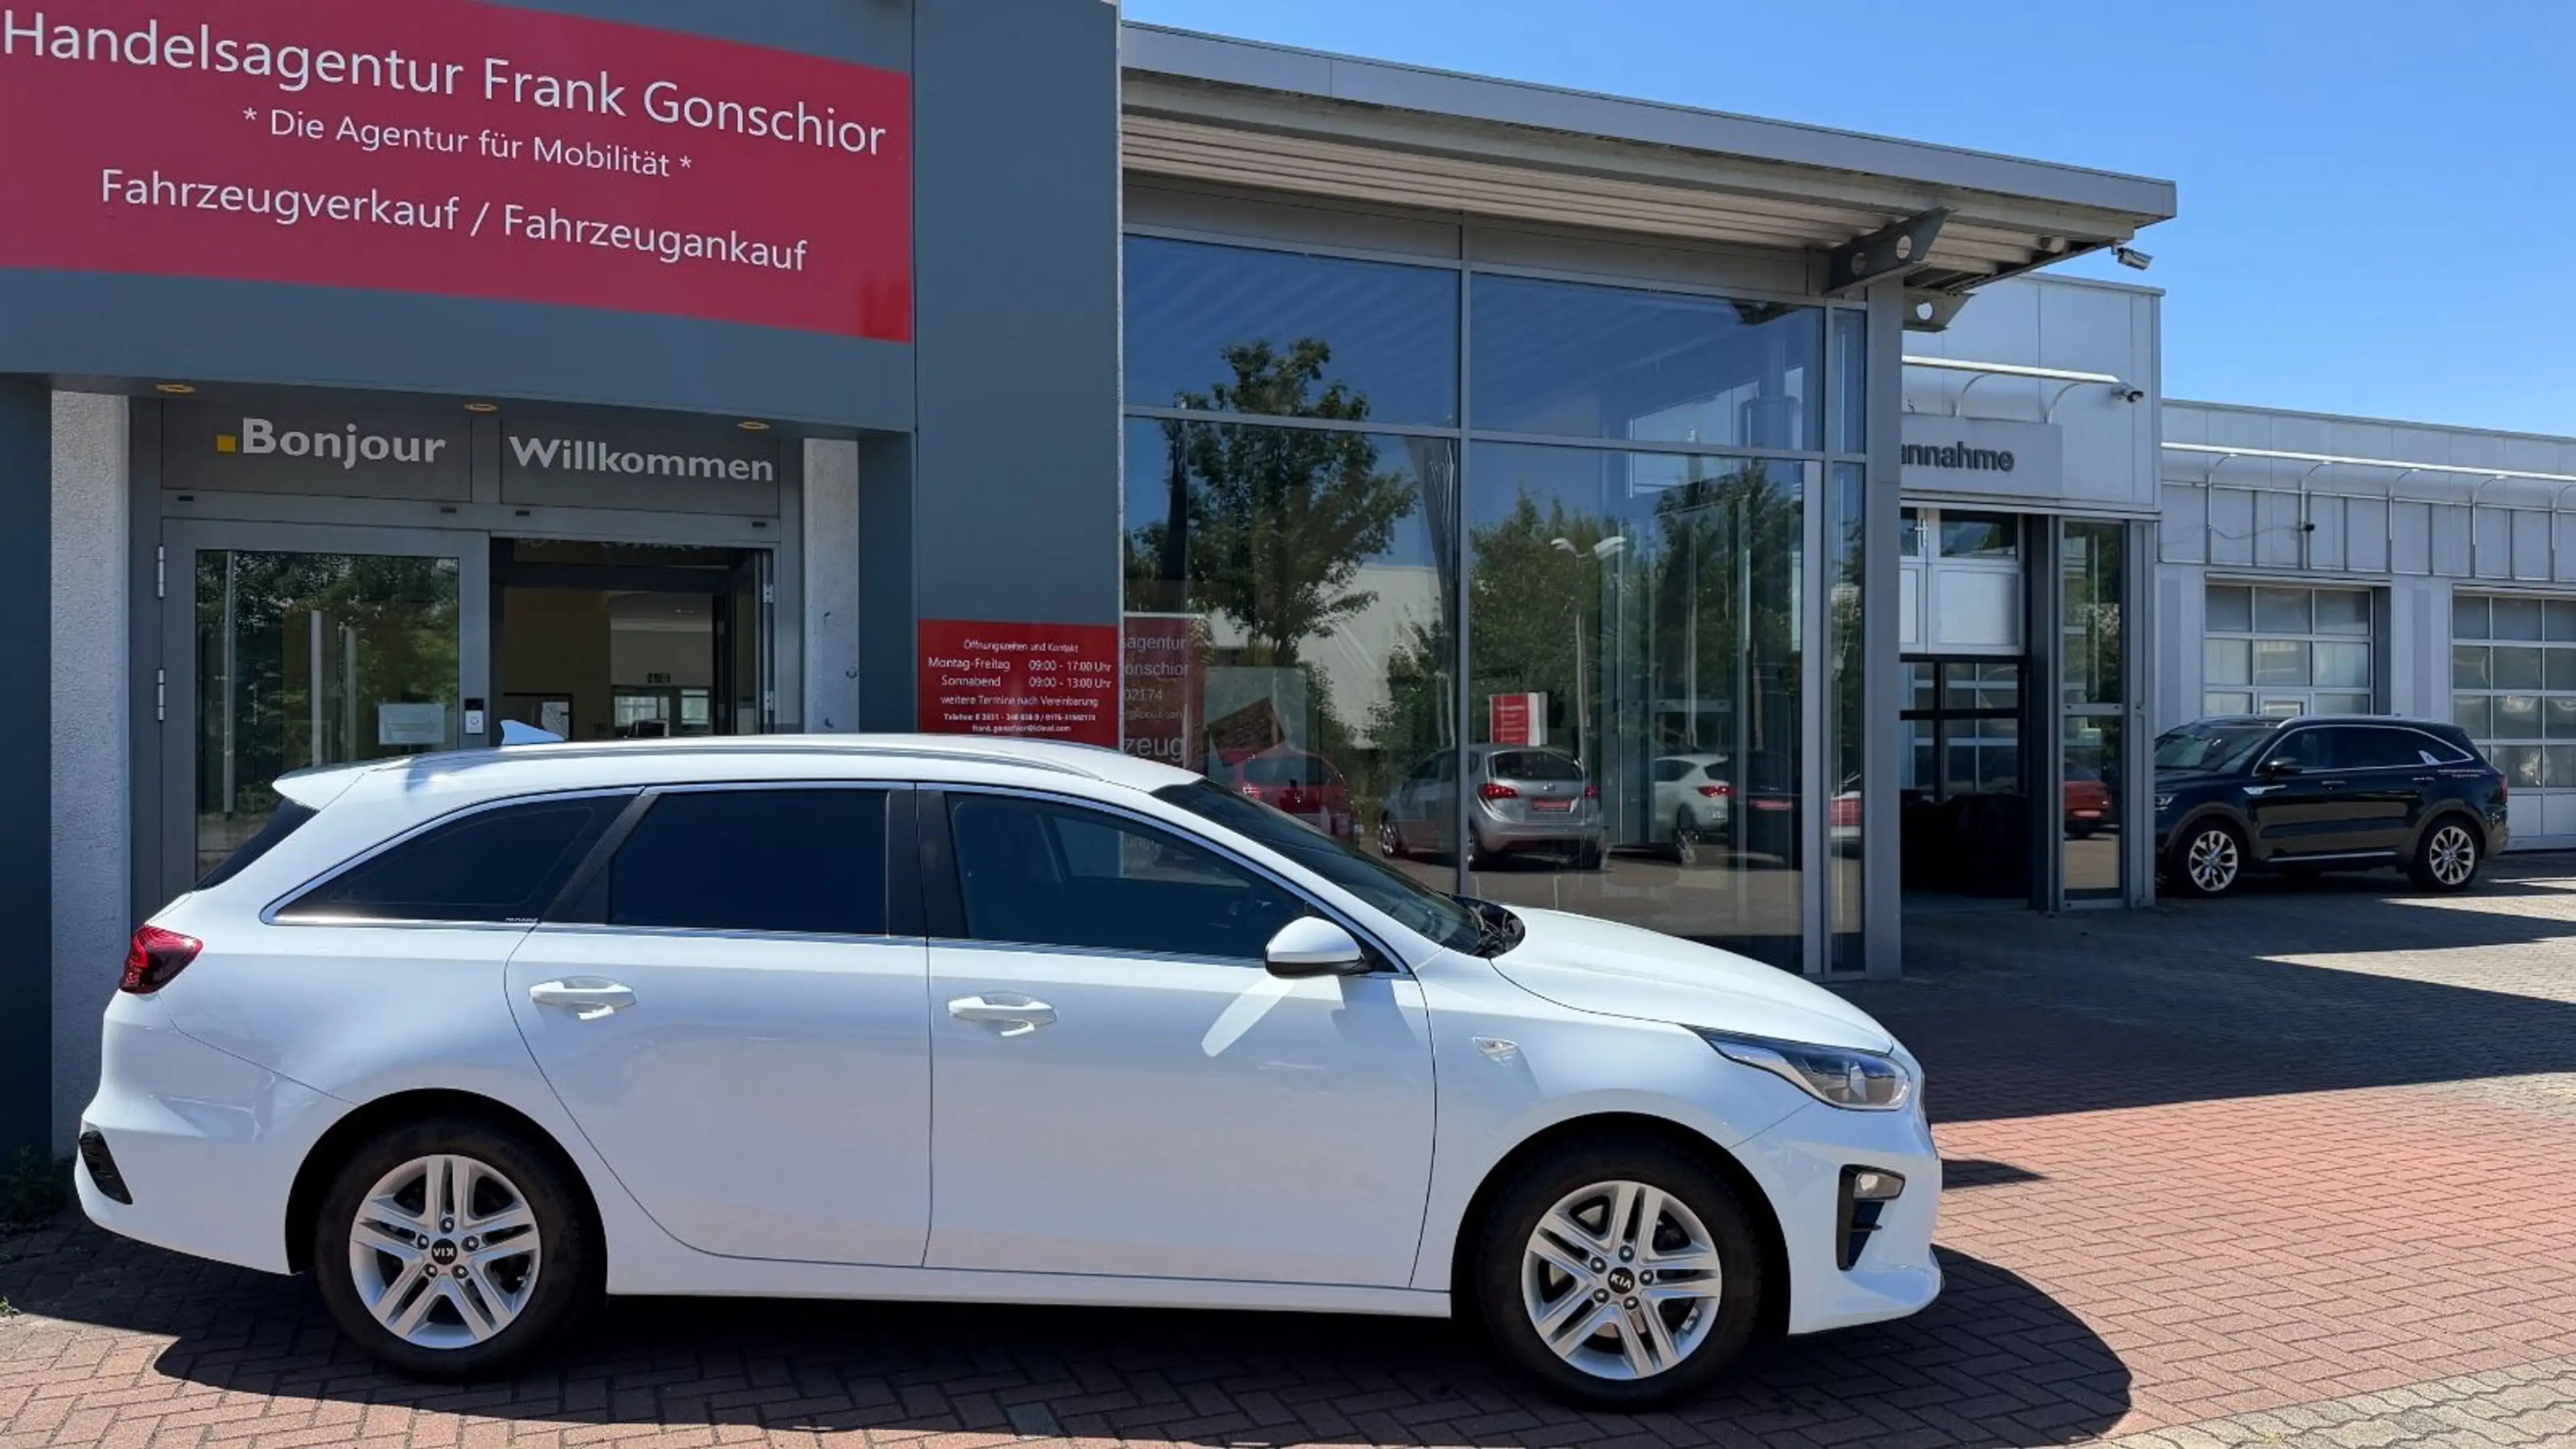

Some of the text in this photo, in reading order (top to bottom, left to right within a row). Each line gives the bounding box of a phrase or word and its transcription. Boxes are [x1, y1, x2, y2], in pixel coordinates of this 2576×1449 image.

[3, 10, 886, 155] Handelsagentur Frank Gonschior
[271, 109, 325, 139] Die
[335, 116, 468, 152] Agentur
[478, 129, 523, 160] für
[534, 136, 670, 178] Mobilität
[102, 169, 808, 272] Fahrzeugverkauf / Fahrzeugankauf
[243, 417, 446, 470] Bonjour
[508, 435, 773, 482] Willkommen
[1030, 643, 1045, 651] und
[1048, 643, 1079, 653] Kontakt
[928, 657, 1011, 672] Montag-Freitag
[1028, 660, 1057, 672] 09:00
[1067, 660, 1092, 673] 17:00
[1094, 661, 1112, 673] Uhr
[941, 675, 1001, 688] Sonnabend
[1028, 677, 1057, 688] 09:00
[1067, 678, 1092, 689] 13:00
[1094, 678, 1112, 689] Uhr
[941, 695, 1099, 708] weitere Termine nach Vereinbarung
[433, 1247, 454, 1257] KIA
[1610, 1273, 1631, 1289] KIA
